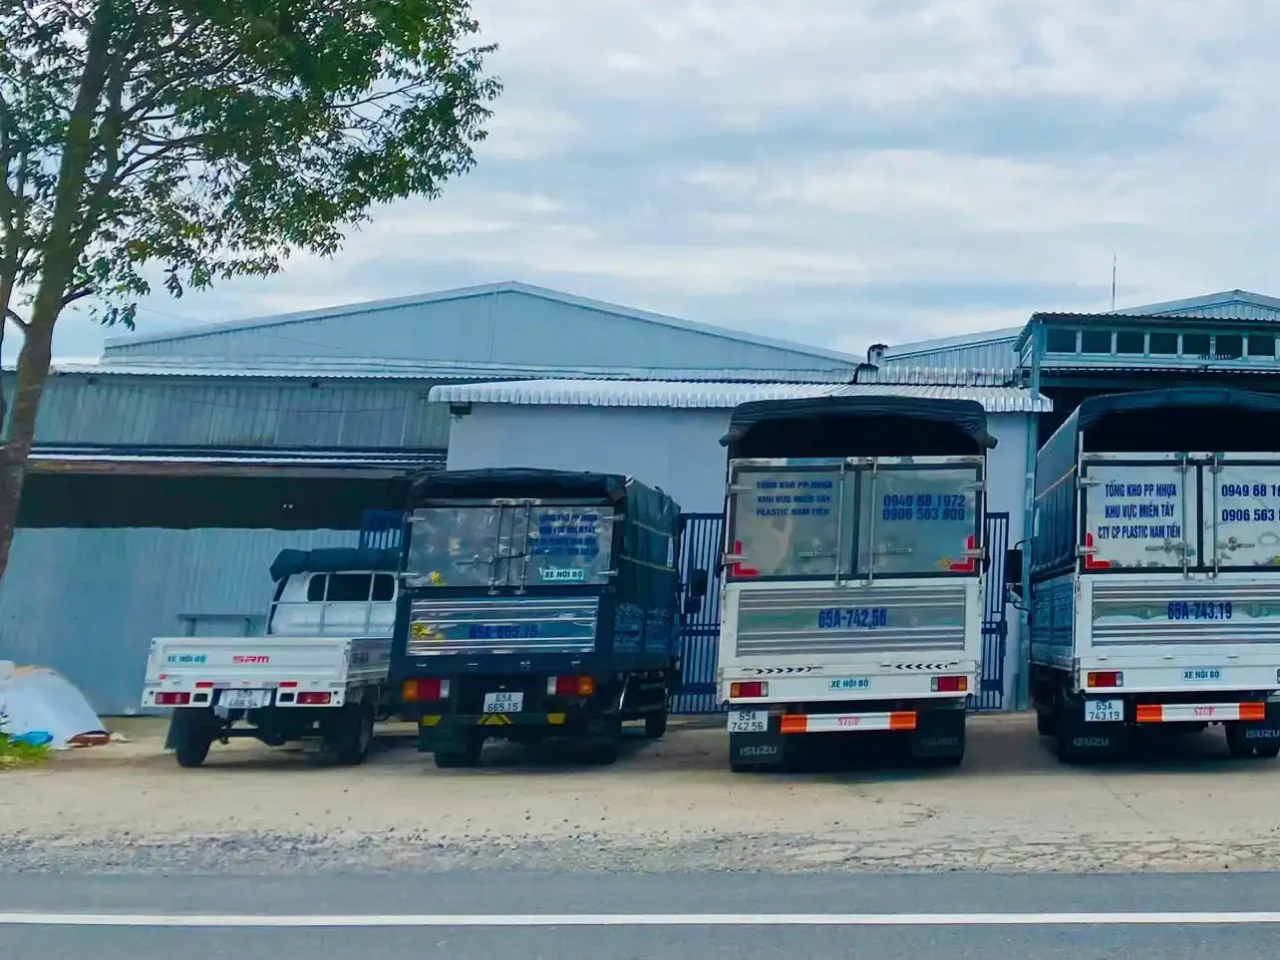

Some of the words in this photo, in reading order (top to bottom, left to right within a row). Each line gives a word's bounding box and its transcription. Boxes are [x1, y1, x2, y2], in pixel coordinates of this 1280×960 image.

[1105, 480, 1125, 497] TỔNG
[1127, 484, 1142, 497] KHO
[1143, 484, 1154, 497] PP
[1156, 483, 1177, 499] NHỰA
[1221, 484, 1249, 497] 0949
[1252, 484, 1267, 497] 68
[883, 494, 913, 507] 0949
[937, 494, 966, 507] 1972
[1105, 504, 1120, 518] KHU
[1122, 503, 1137, 520] VỰC
[1160, 501, 1175, 517] TÂY
[1221, 509, 1249, 522] 0906
[1253, 509, 1275, 521] 563
[1098, 526, 1110, 539] CTY
[1111, 526, 1121, 539] CP
[1121, 525, 1148, 538] PLASTIC
[1149, 525, 1165, 538] NAM
[545, 570, 554, 578] XE
[1184, 671, 1194, 679] XE
[831, 680, 841, 688] XE
[1096, 701, 1113, 710] 65A
[739, 712, 756, 721] 65A
[1088, 711, 1120, 720] 743.19
[740, 745, 777, 756] ISUZU
